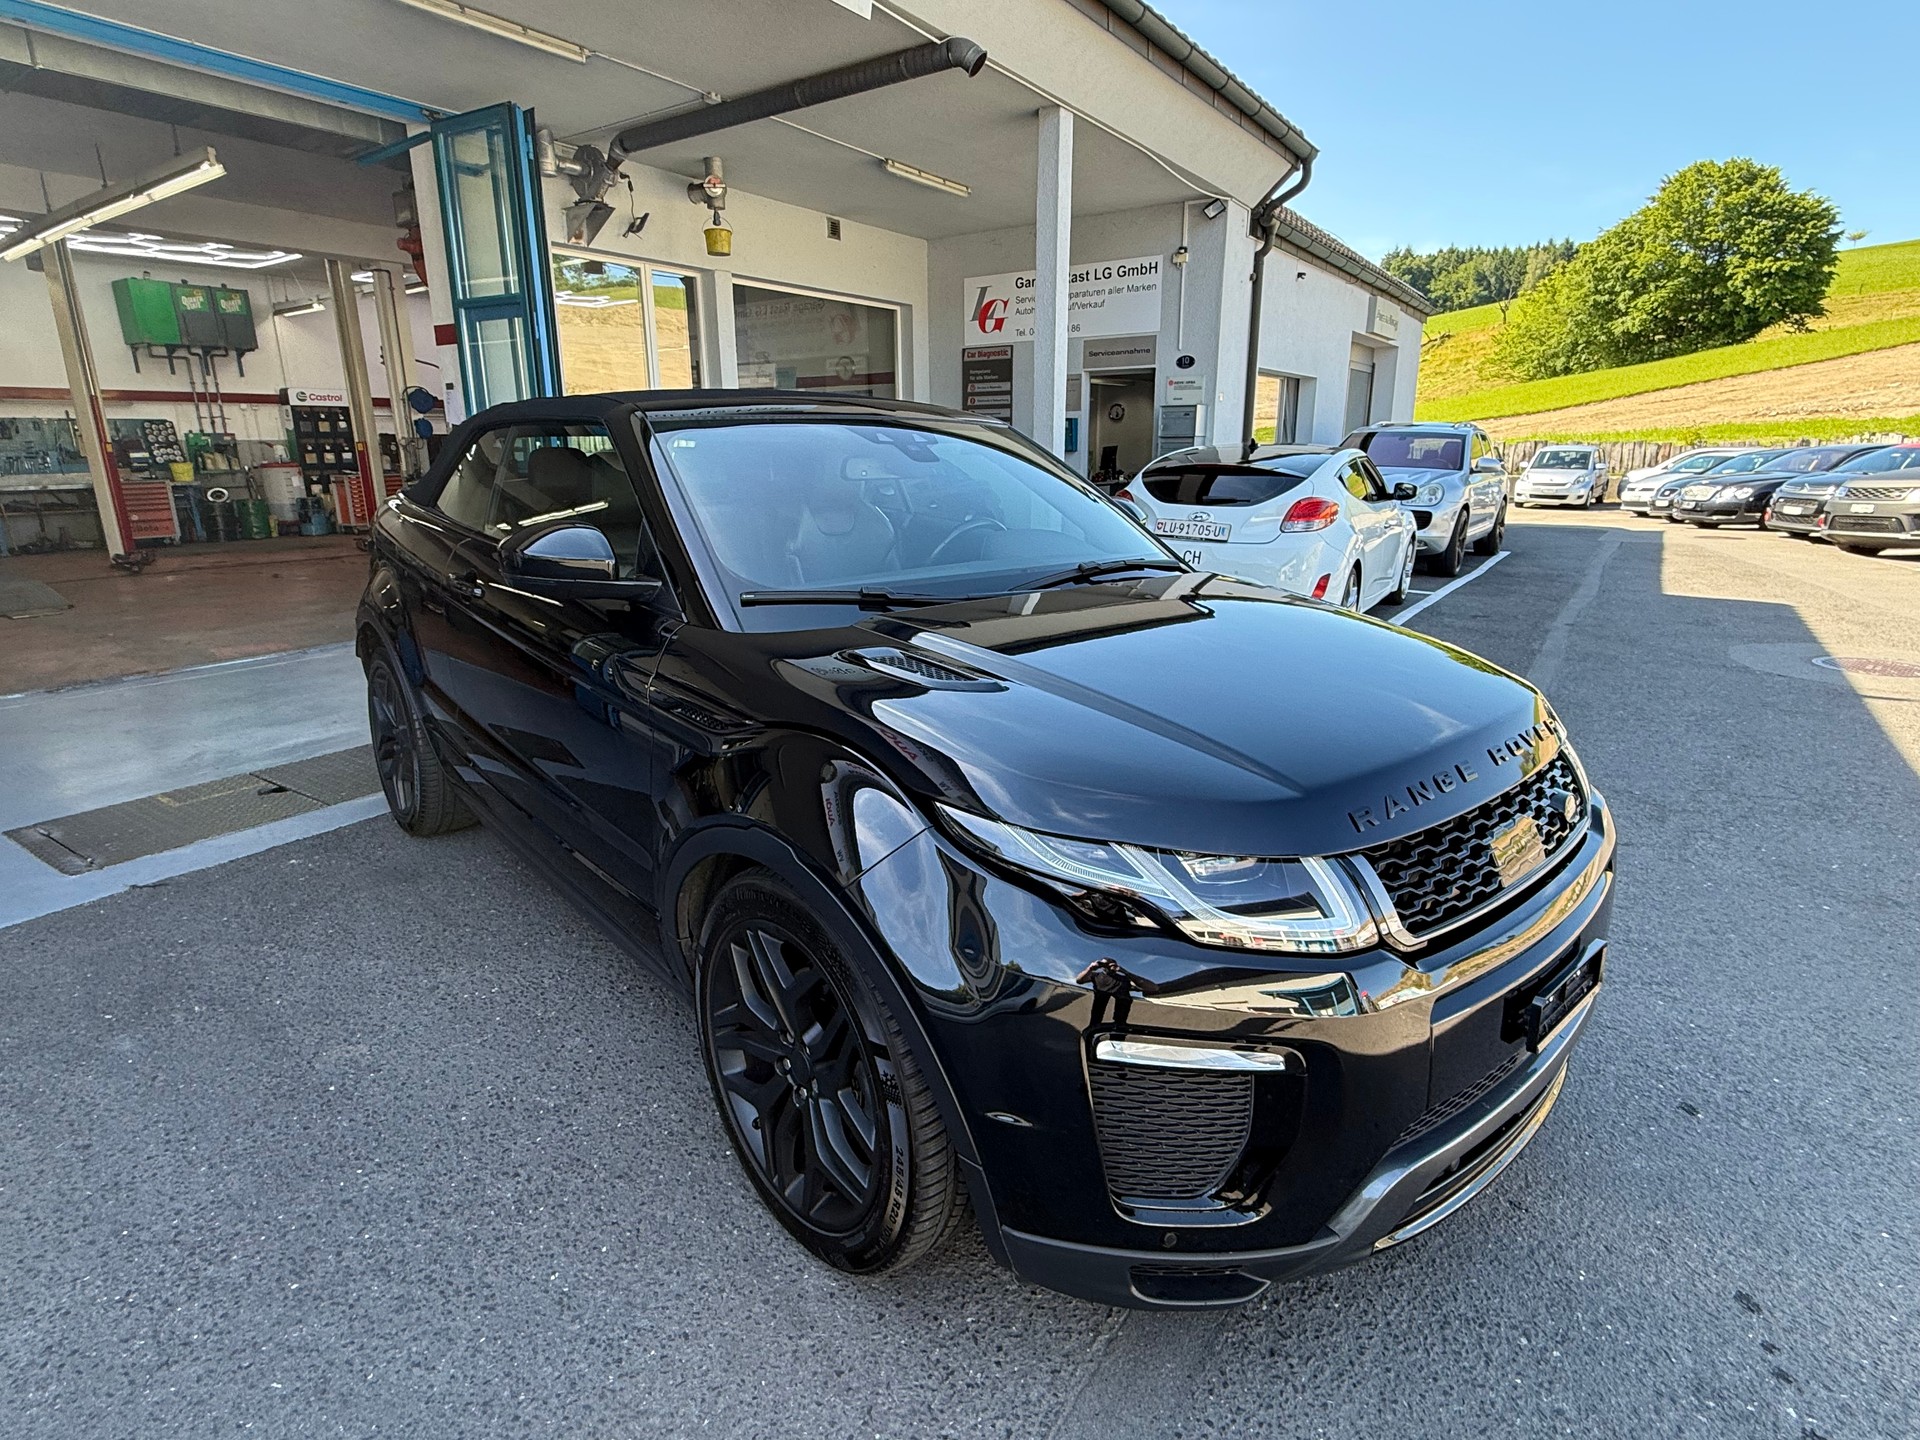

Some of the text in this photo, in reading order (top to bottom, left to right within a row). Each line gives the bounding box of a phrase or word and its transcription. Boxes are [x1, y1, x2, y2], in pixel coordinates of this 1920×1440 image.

[1015, 277, 1036, 289] Gar
[1094, 267, 1112, 281] LG
[1117, 261, 1158, 278] GmbH
[1068, 288, 1106, 300] paraturen
[1107, 286, 1125, 295] aller
[1126, 283, 1157, 293] Marken
[1015, 328, 1028, 337] Tel.
[1070, 324, 1081, 333] 86
[966, 349, 1009, 359] Car Diagnostic
[1088, 347, 1151, 357] Serviceannahme
[1181, 356, 1190, 364] 10
[309, 393, 343, 402] Castrol
[1183, 550, 1202, 565] CH
[1346, 760, 1479, 834] RANGE
